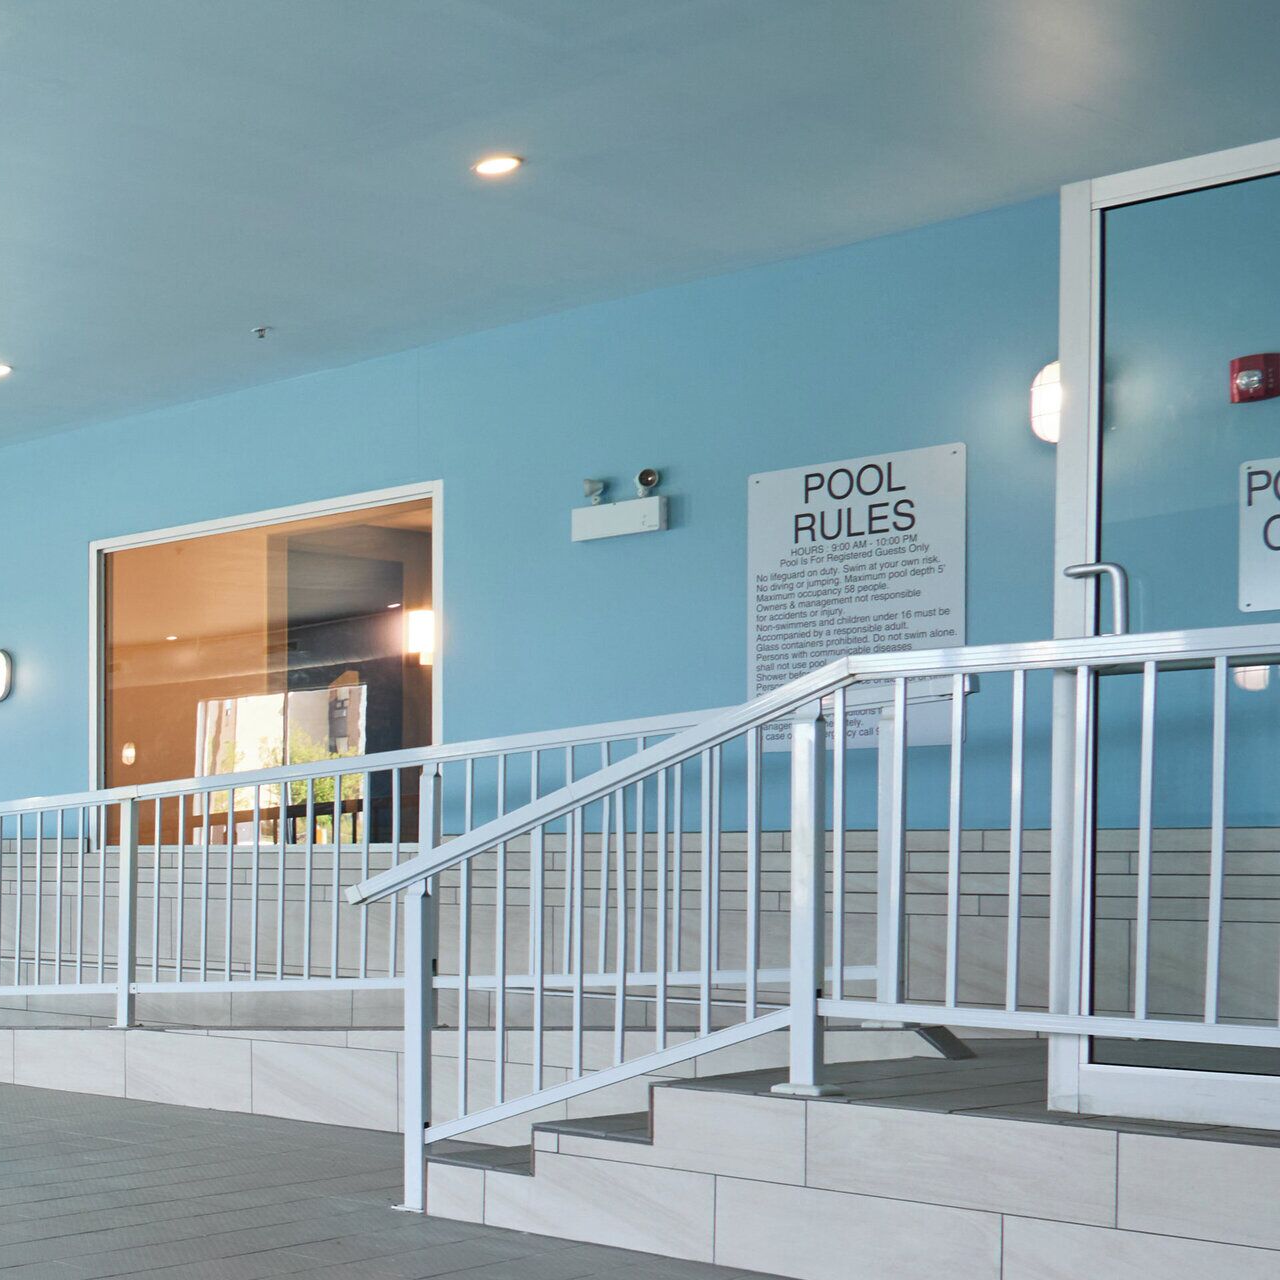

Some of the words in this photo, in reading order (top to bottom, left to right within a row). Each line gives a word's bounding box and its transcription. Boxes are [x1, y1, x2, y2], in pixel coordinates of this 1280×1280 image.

[804, 461, 906, 504] POOL
[1247, 470, 1280, 507] P
[794, 498, 916, 544] RULES
[780, 557, 798, 567] Pool
[810, 555, 825, 564] For
[826, 549, 872, 562] Registered
[875, 545, 906, 556] Guests
[908, 542, 929, 553] Only
[791, 545, 824, 556] HOURS
[852, 539, 866, 549] AM
[902, 533, 917, 543] PM
[756, 574, 768, 582] No
[770, 569, 805, 581] lifeguard
[843, 563, 866, 572] Swim
[868, 561, 877, 570] at
[879, 561, 899, 571] your
[900, 558, 919, 566] own
[756, 584, 767, 592] No
[770, 582, 793, 591] diving
[844, 573, 885, 583] Maximum
[888, 569, 907, 580] pool
[910, 566, 935, 577] depth
[756, 592, 795, 602] Maximum
[797, 587, 841, 598] occupancy
[844, 584, 855, 593] 58
[756, 603, 787, 612] Owners
[789, 601, 795, 609] &
[798, 595, 852, 608] management
[855, 593, 868, 603] not
[870, 589, 921, 602] responsible
[756, 614, 766, 622] for
[769, 610, 807, 621] accidents
[819, 617, 834, 626] and
[837, 615, 870, 624] children
[872, 612, 897, 621] under
[902, 610, 912, 619] 16
[914, 608, 936, 618] must
[938, 607, 950, 616] be
[756, 630, 811, 641] Accompanied
[813, 629, 823, 638] by
[833, 624, 882, 636] responsible
[756, 643, 779, 651] Glass
[781, 640, 823, 649] containers
[873, 634, 885, 642] Do
[887, 632, 901, 641] not
[904, 631, 927, 640] swim
[929, 629, 957, 638] alone.
[756, 653, 789, 661] Persons
[792, 650, 807, 659] with
[809, 646, 871, 657] communicable
[873, 644, 912, 653] diseases
[756, 663, 774, 671] shall
[777, 662, 789, 670] not
[756, 673, 787, 681] Shower
